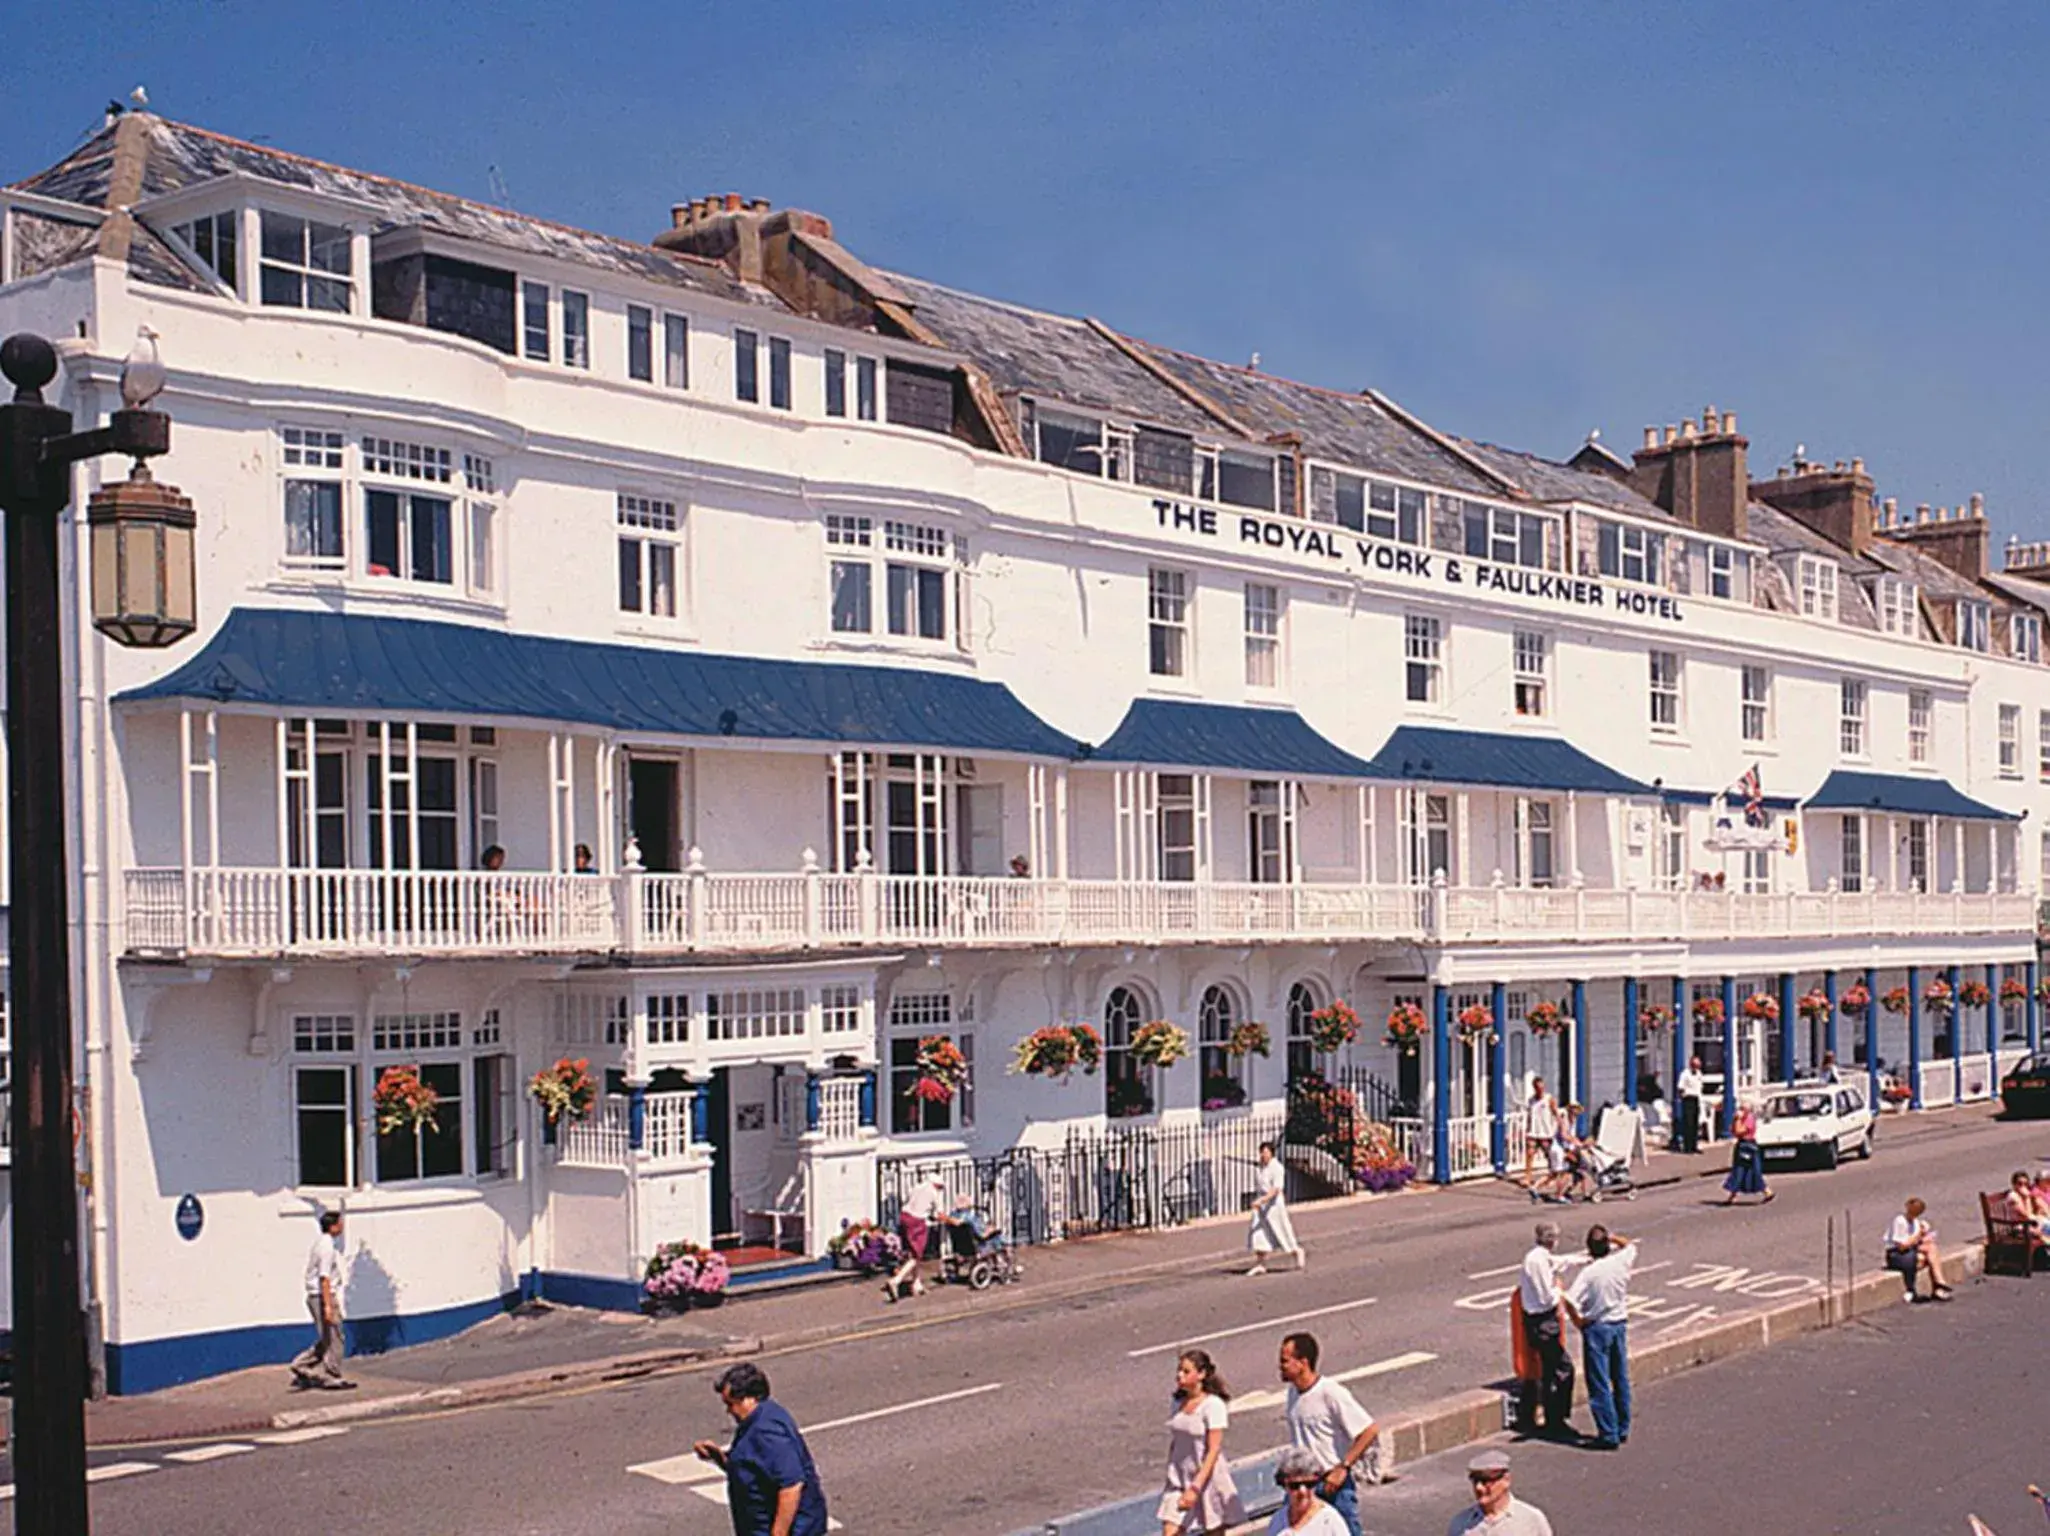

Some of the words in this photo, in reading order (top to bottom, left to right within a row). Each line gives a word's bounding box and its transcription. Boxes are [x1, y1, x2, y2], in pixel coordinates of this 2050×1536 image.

[1151, 499, 1218, 536] THE
[1240, 517, 1343, 559] ROYAL
[1356, 541, 1432, 578] YORK
[1445, 558, 1463, 583] &
[1475, 564, 1604, 607] FAULKNER
[1616, 589, 1684, 622] HOTEL
